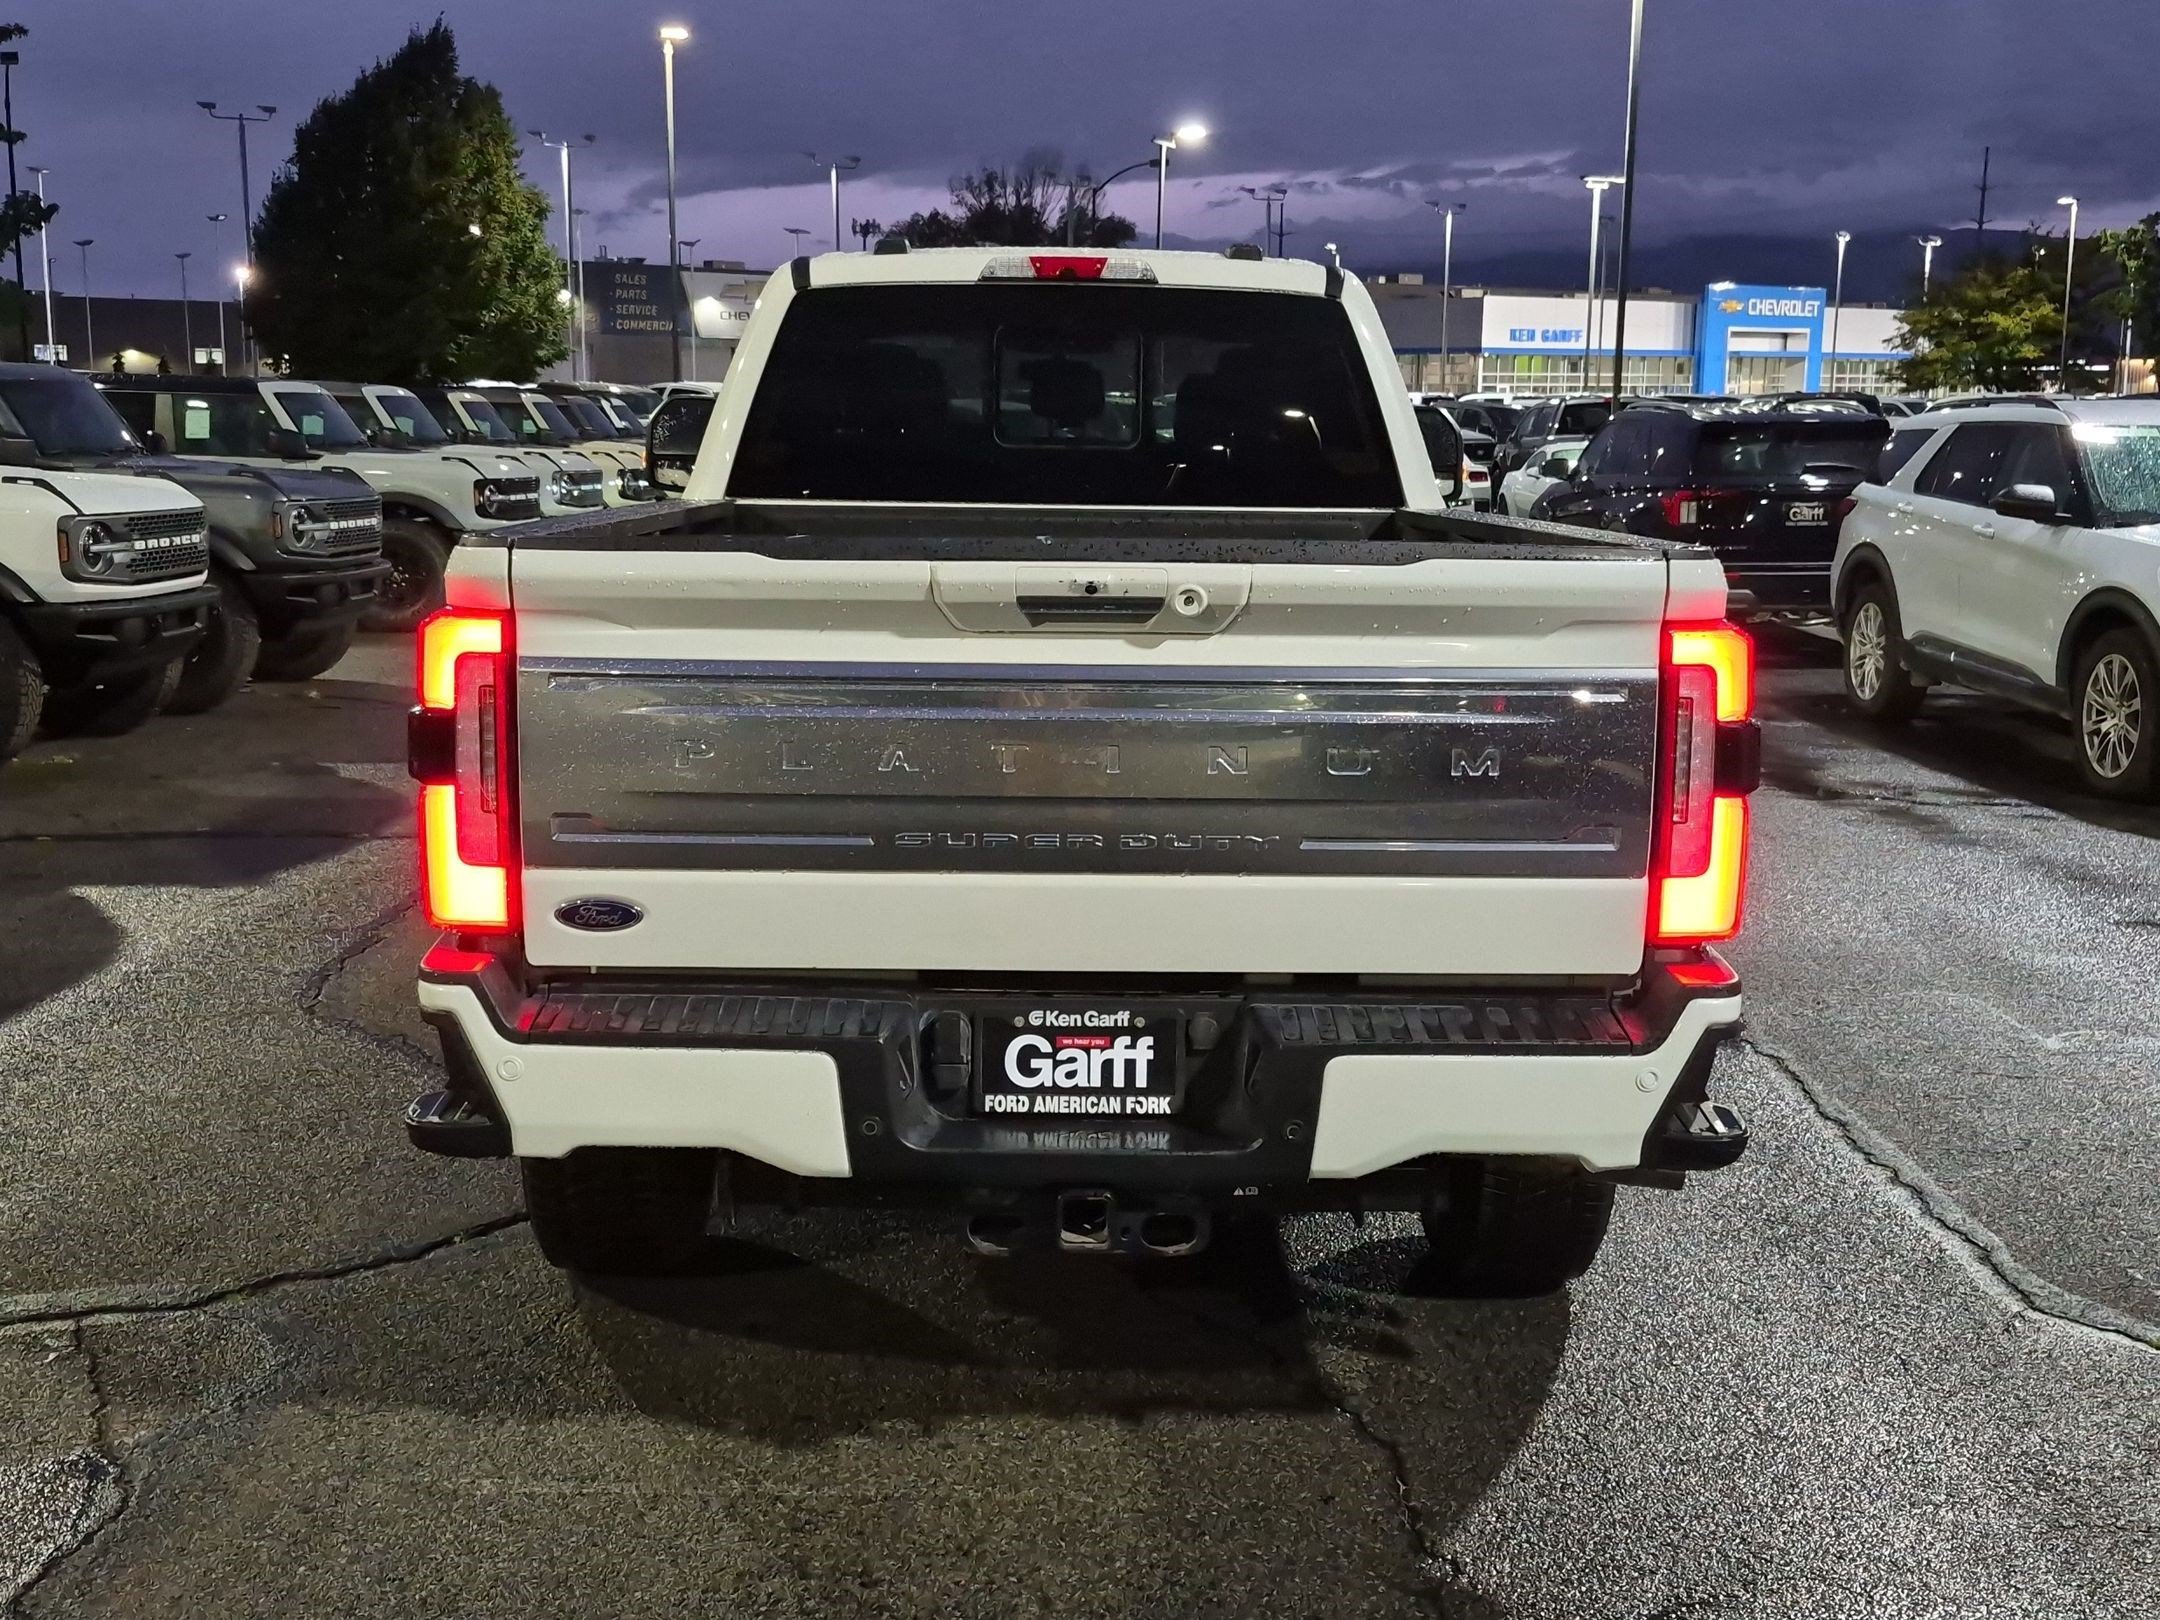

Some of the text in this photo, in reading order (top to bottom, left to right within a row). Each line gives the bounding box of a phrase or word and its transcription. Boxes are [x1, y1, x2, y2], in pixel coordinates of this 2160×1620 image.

[614, 273, 647, 285] SALES
[615, 289, 647, 300] PARTS
[616, 304, 658, 315] SERVICE
[1748, 298, 1821, 317] CHEVROLET
[1509, 328, 1536, 342] KEN
[330, 517, 378, 530] BRONCO
[674, 738, 1500, 780] PLATINUM
[895, 831, 1280, 851] SUPER DUTY
[574, 904, 623, 926] Ford
[1045, 1010, 1130, 1027] Ken Garff
[1091, 1039, 1105, 1047] you
[1004, 1034, 1154, 1088] Garff
[984, 1094, 1172, 1115] FORD AMERICAN FORK
